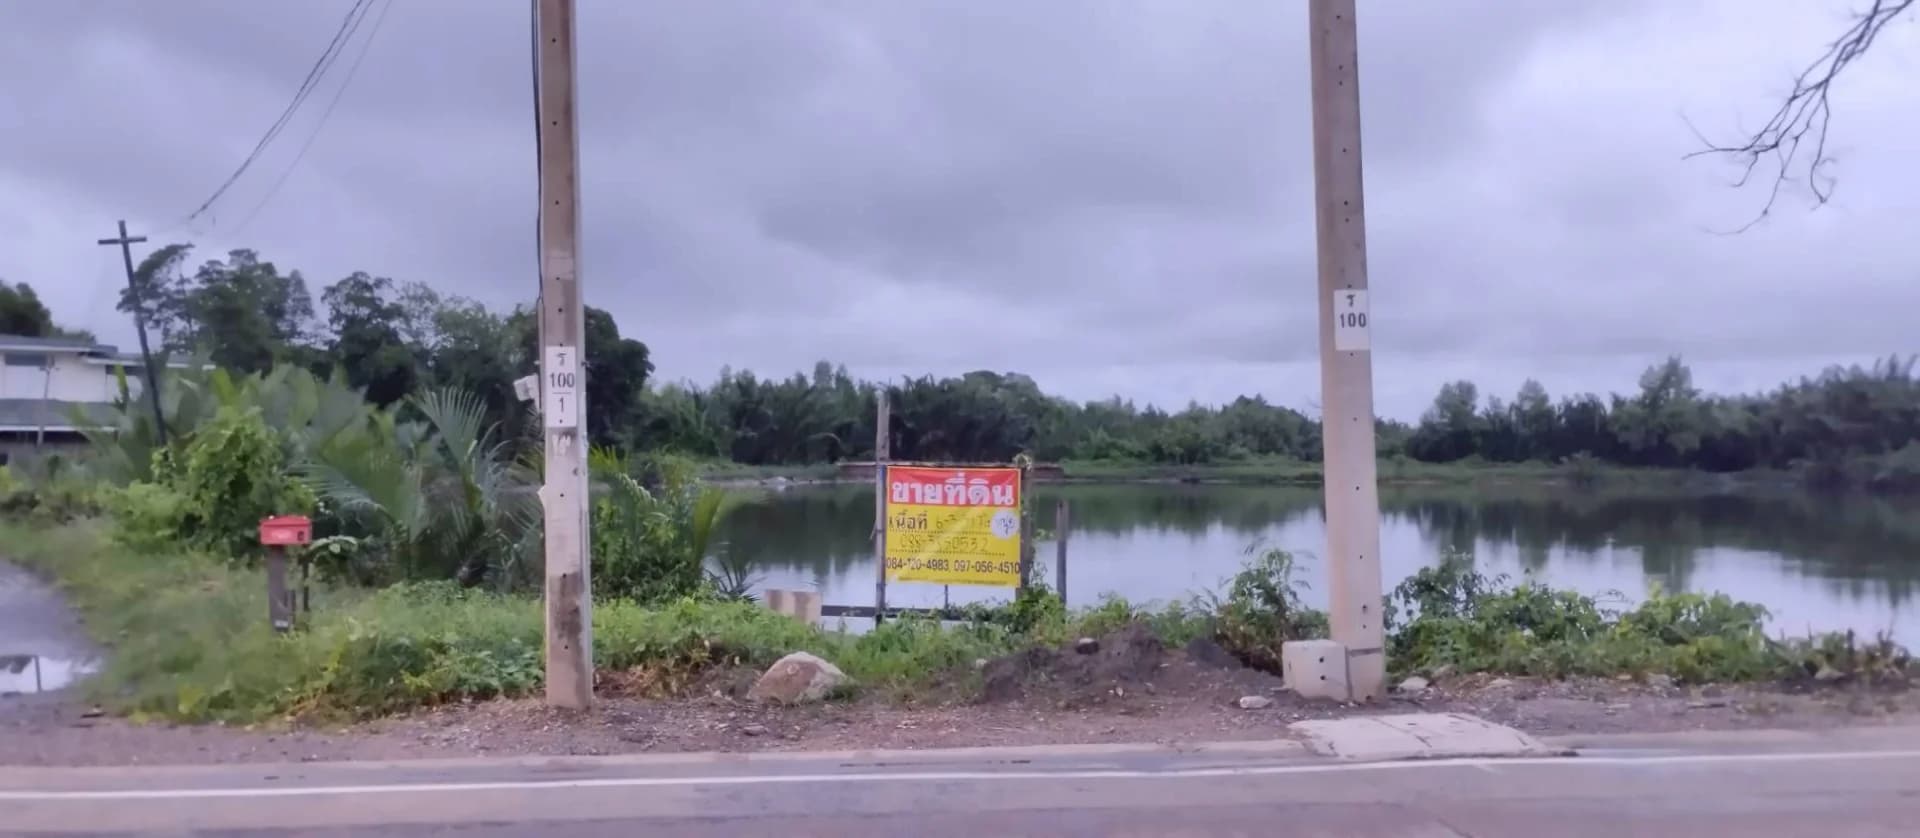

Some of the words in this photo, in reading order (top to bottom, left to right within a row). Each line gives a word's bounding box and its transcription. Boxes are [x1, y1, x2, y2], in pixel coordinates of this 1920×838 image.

[1340, 312, 1367, 328] 100
[549, 372, 576, 388] 100
[559, 396, 566, 413] 1
[892, 471, 1015, 506] ขายที่ดิน
[889, 508, 928, 530] เนื้อที่
[953, 559, 1021, 575] 097-056-4510
